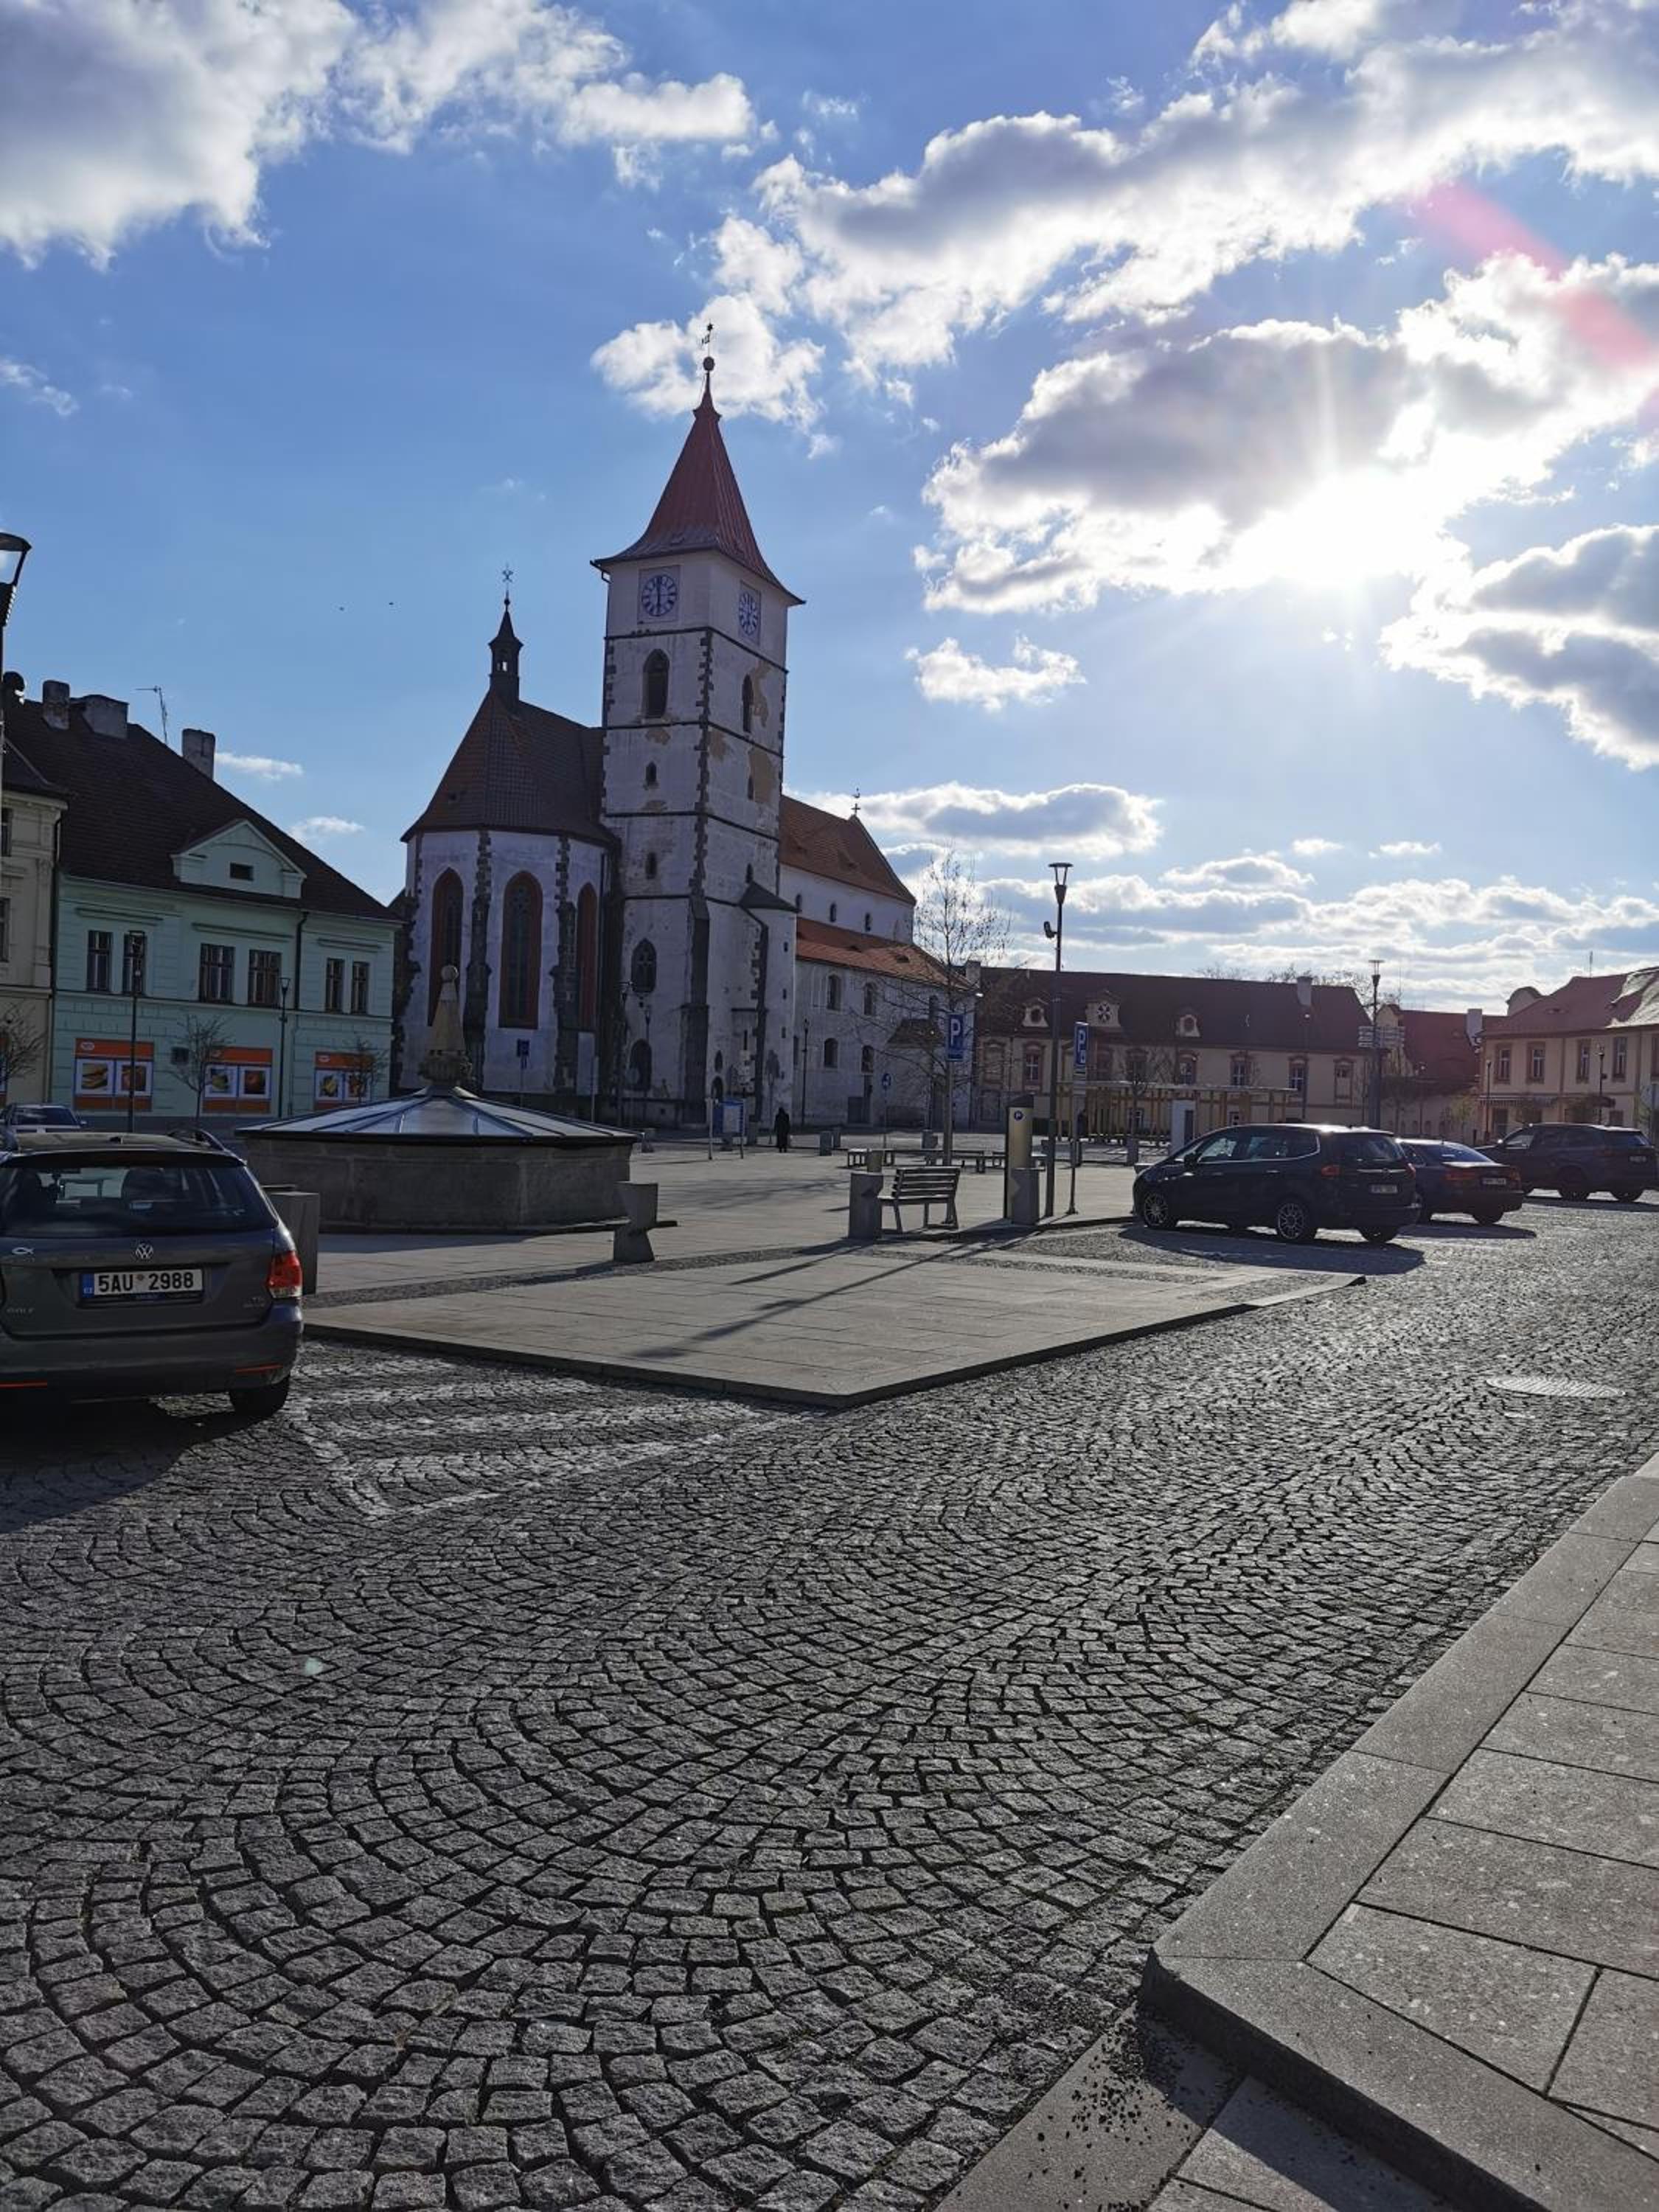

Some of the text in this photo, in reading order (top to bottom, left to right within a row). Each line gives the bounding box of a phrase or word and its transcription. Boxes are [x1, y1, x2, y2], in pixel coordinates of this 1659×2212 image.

[950, 1018, 961, 1046] P
[1077, 1029, 1086, 1053] P
[98, 1272, 194, 1293] 5AU 2988
